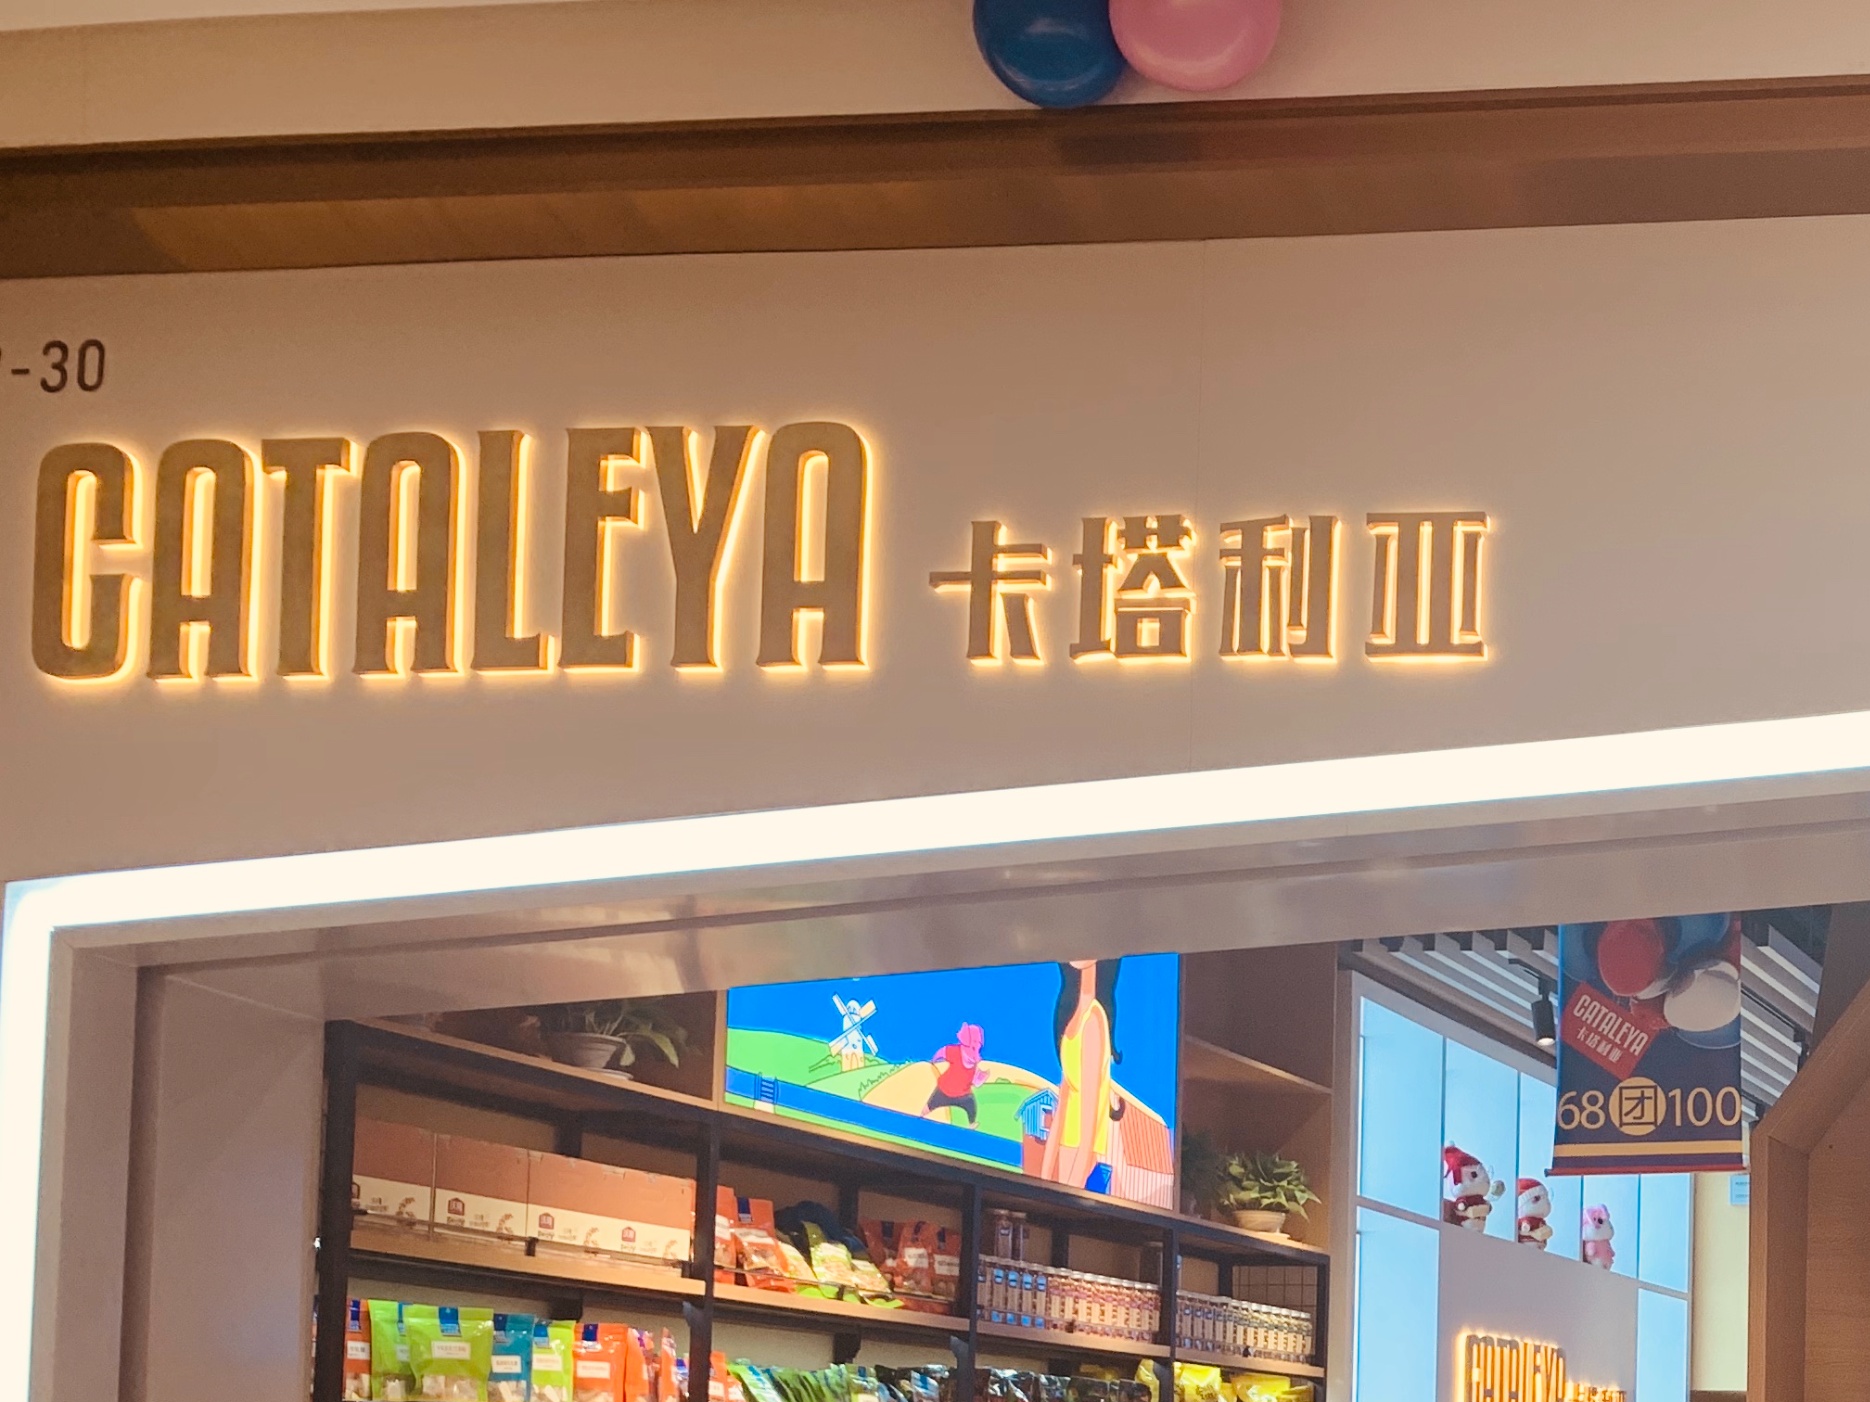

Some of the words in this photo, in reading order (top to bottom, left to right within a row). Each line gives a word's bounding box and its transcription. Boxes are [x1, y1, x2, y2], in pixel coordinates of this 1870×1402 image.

[0, 338, 106, 393] -30
[31, 421, 872, 678] CATALEYA
[928, 512, 1490, 662] 卡塔利亚
[1572, 995, 1648, 1056] CATALEYA
